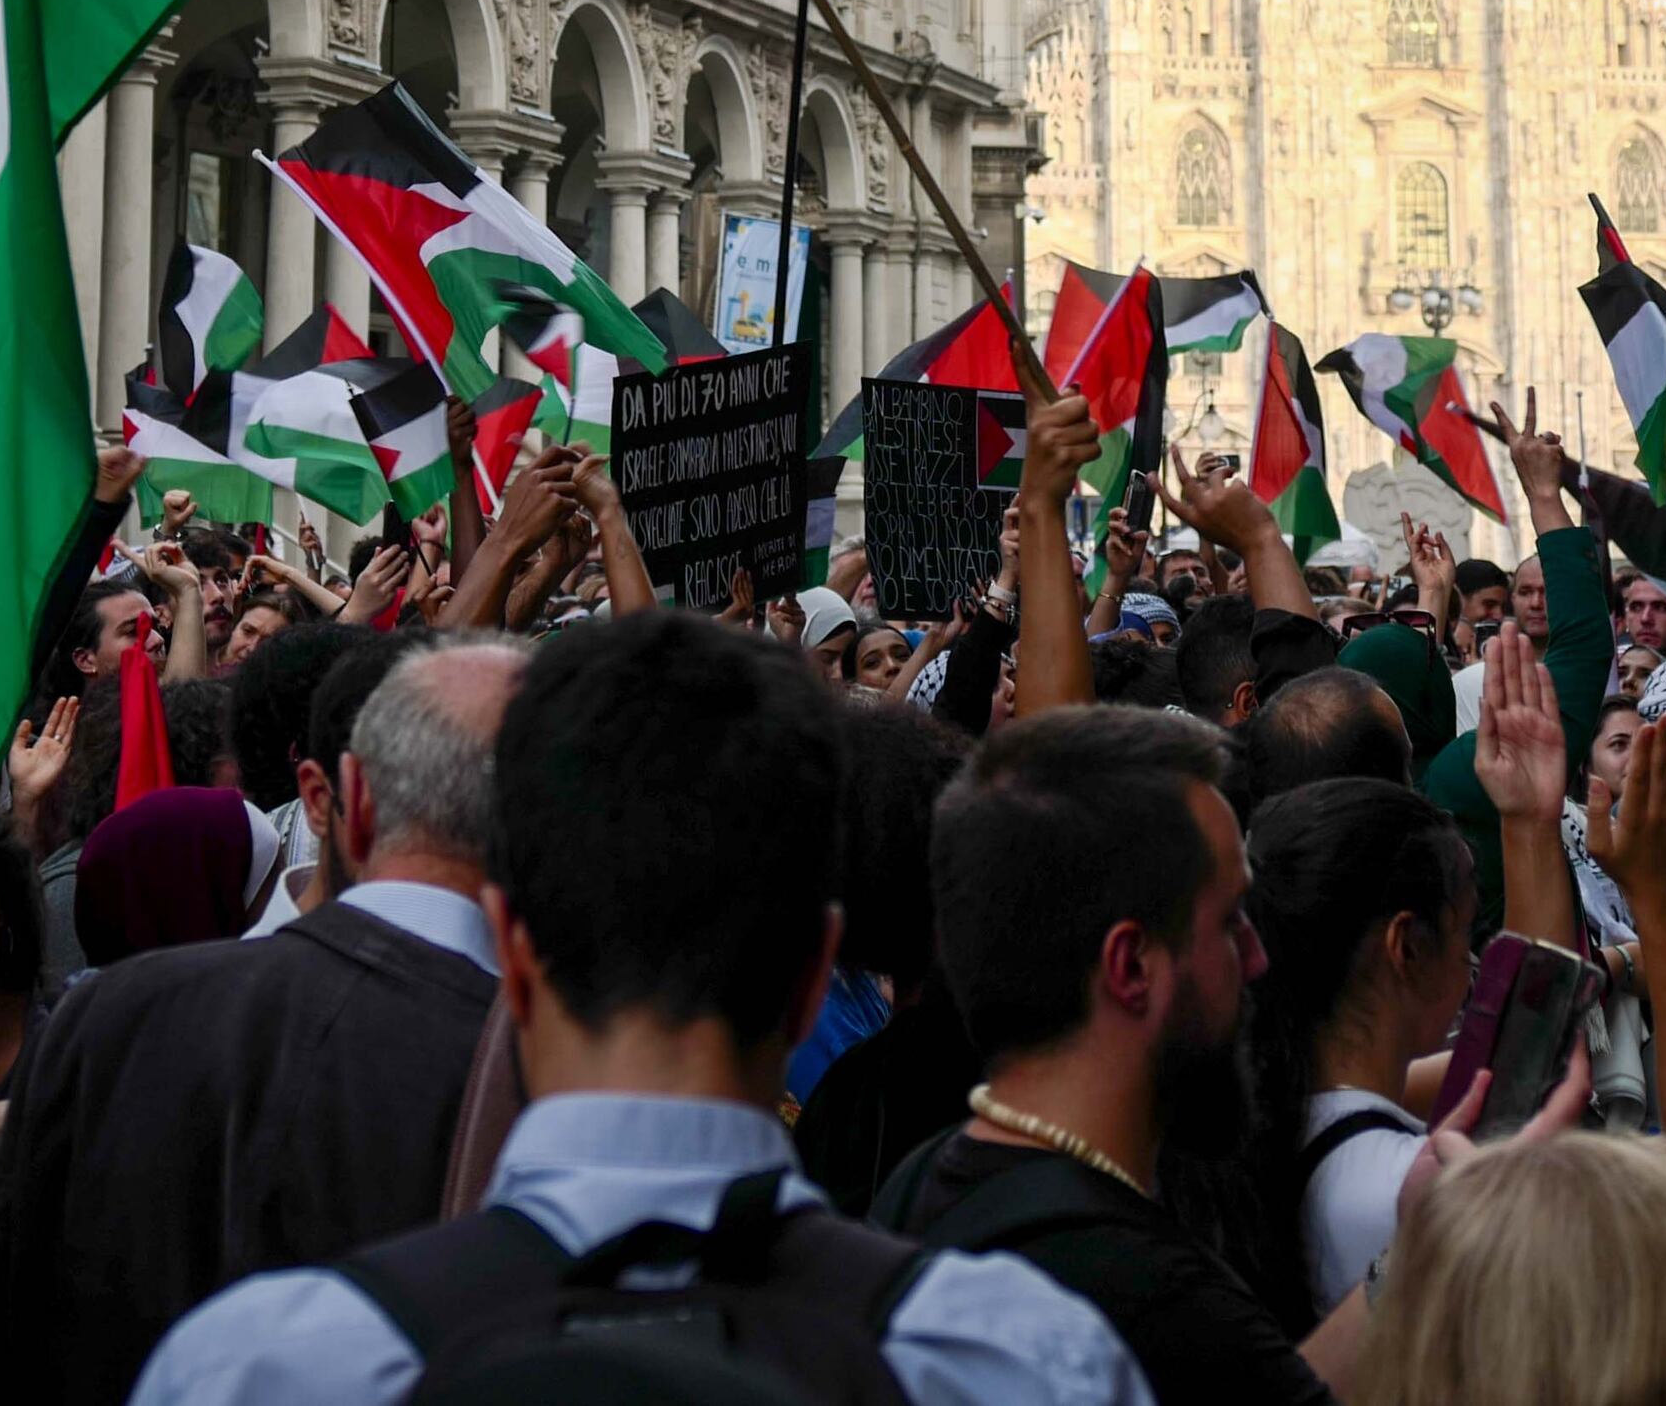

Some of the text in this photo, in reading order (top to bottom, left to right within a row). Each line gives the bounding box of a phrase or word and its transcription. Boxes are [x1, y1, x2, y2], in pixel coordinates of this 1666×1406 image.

[621, 385, 647, 433] DA
[681, 375, 697, 418] DI
[700, 372, 725, 415] 70
[729, 362, 759, 408] ANNI
[763, 354, 791, 399] CHE
[891, 386, 964, 423] BAMBINO
[621, 443, 666, 495] ISRAELE
[667, 432, 719, 484] BOMBARDA
[779, 412, 798, 454] VOI
[864, 414, 964, 454] PALESTINESE
[913, 450, 965, 487] RAZZI
[637, 499, 686, 552] SVEGLIATE
[689, 493, 721, 542] SOLO
[725, 483, 757, 534] ADESSO
[759, 476, 779, 524] CHE
[866, 481, 989, 520] POTREBBERO
[867, 512, 916, 546] SOPRA
[918, 514, 939, 547] DI
[899, 546, 1001, 581] DIMENTICATO
